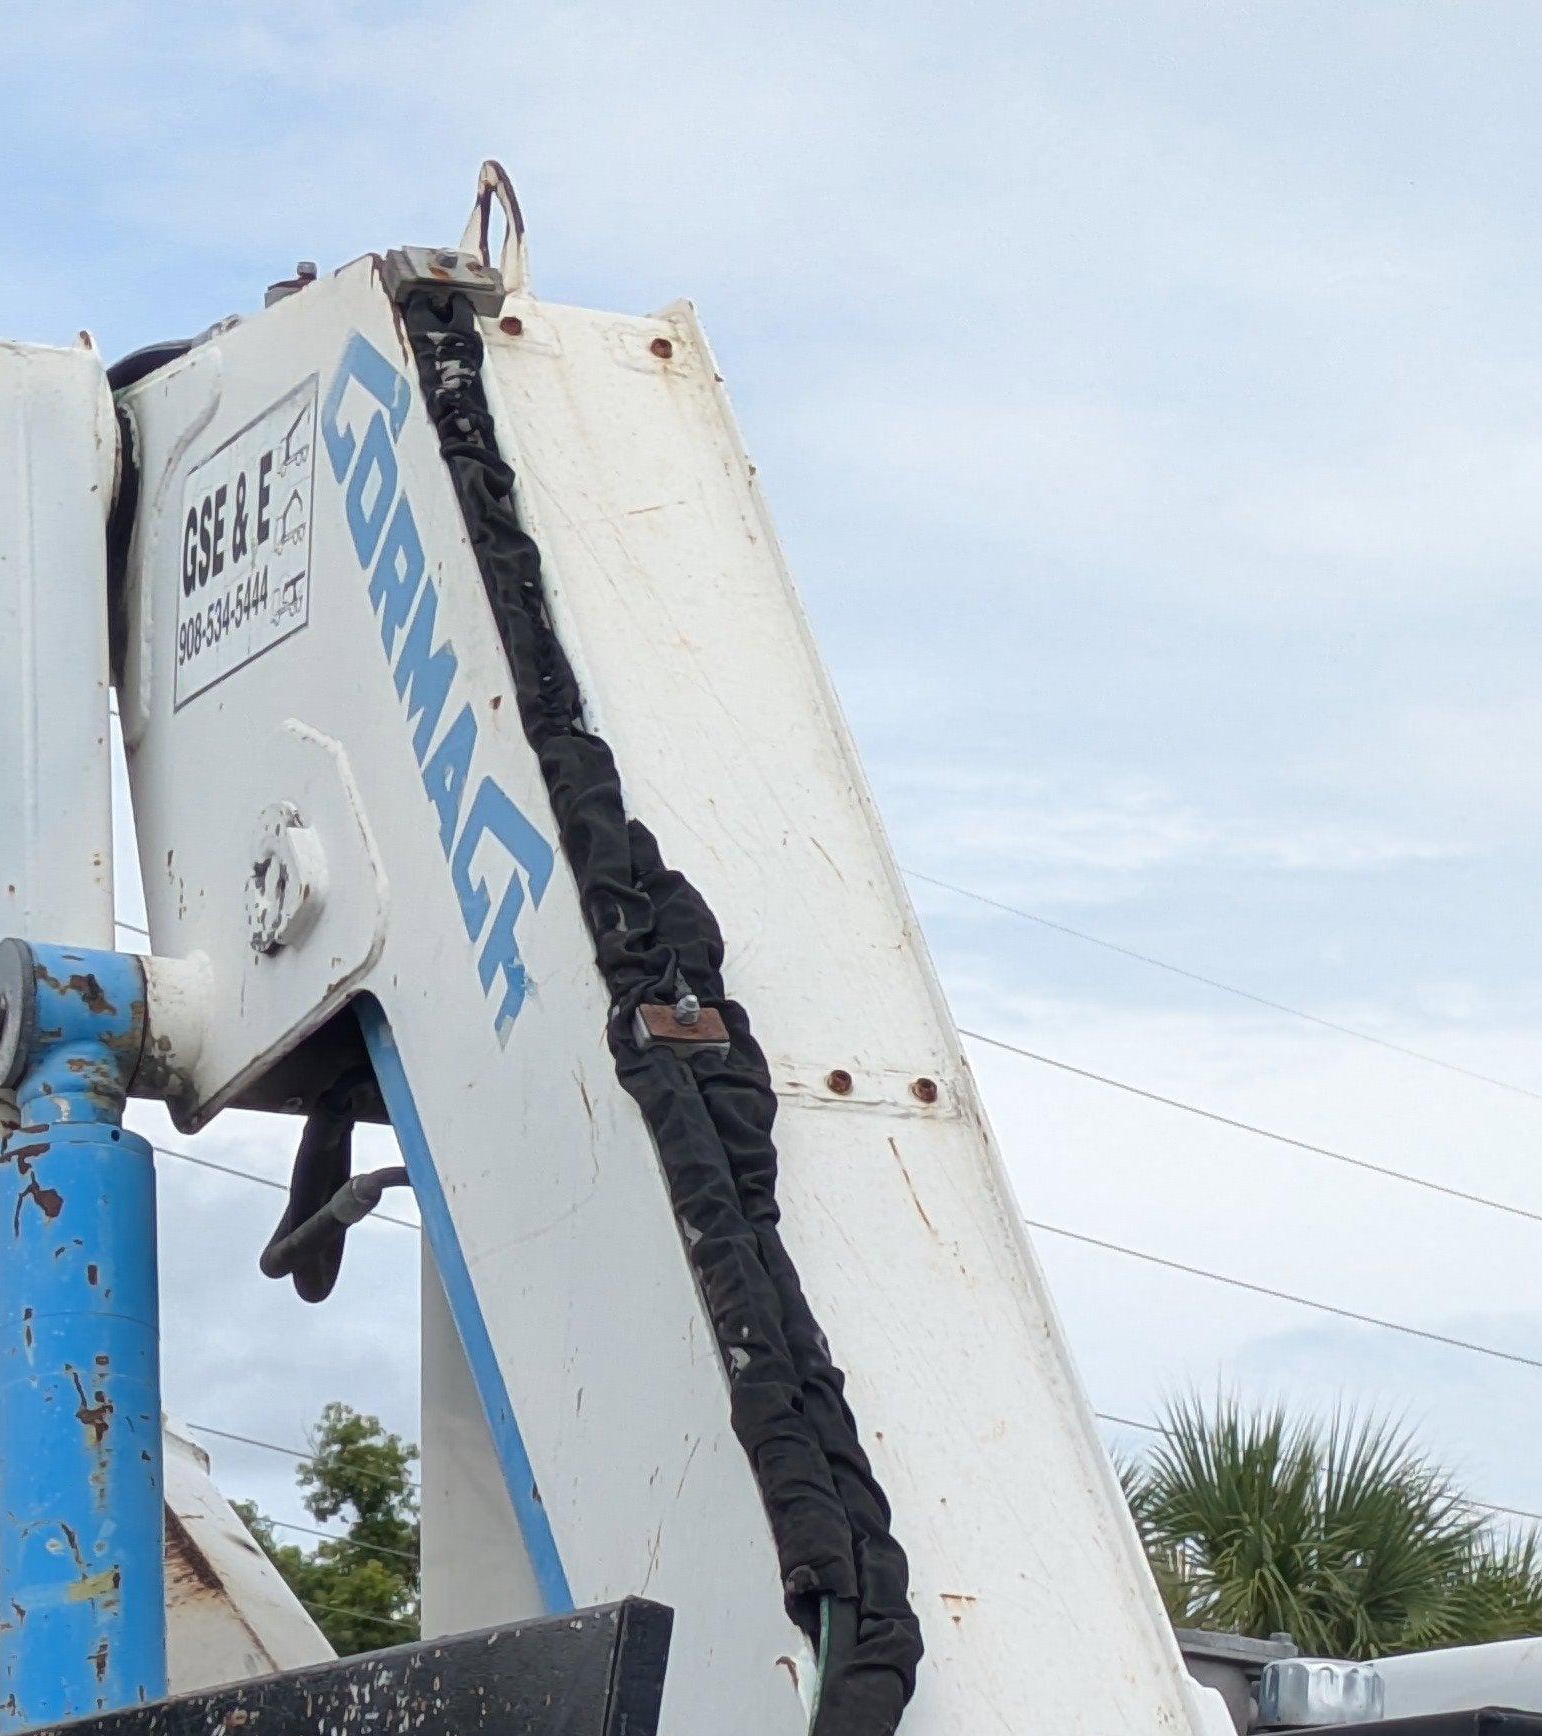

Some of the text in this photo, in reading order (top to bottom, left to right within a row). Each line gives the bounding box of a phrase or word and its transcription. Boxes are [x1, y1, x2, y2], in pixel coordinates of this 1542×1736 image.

[182, 450, 273, 598] GSE & E
[179, 565, 268, 666] 908-534-5444
